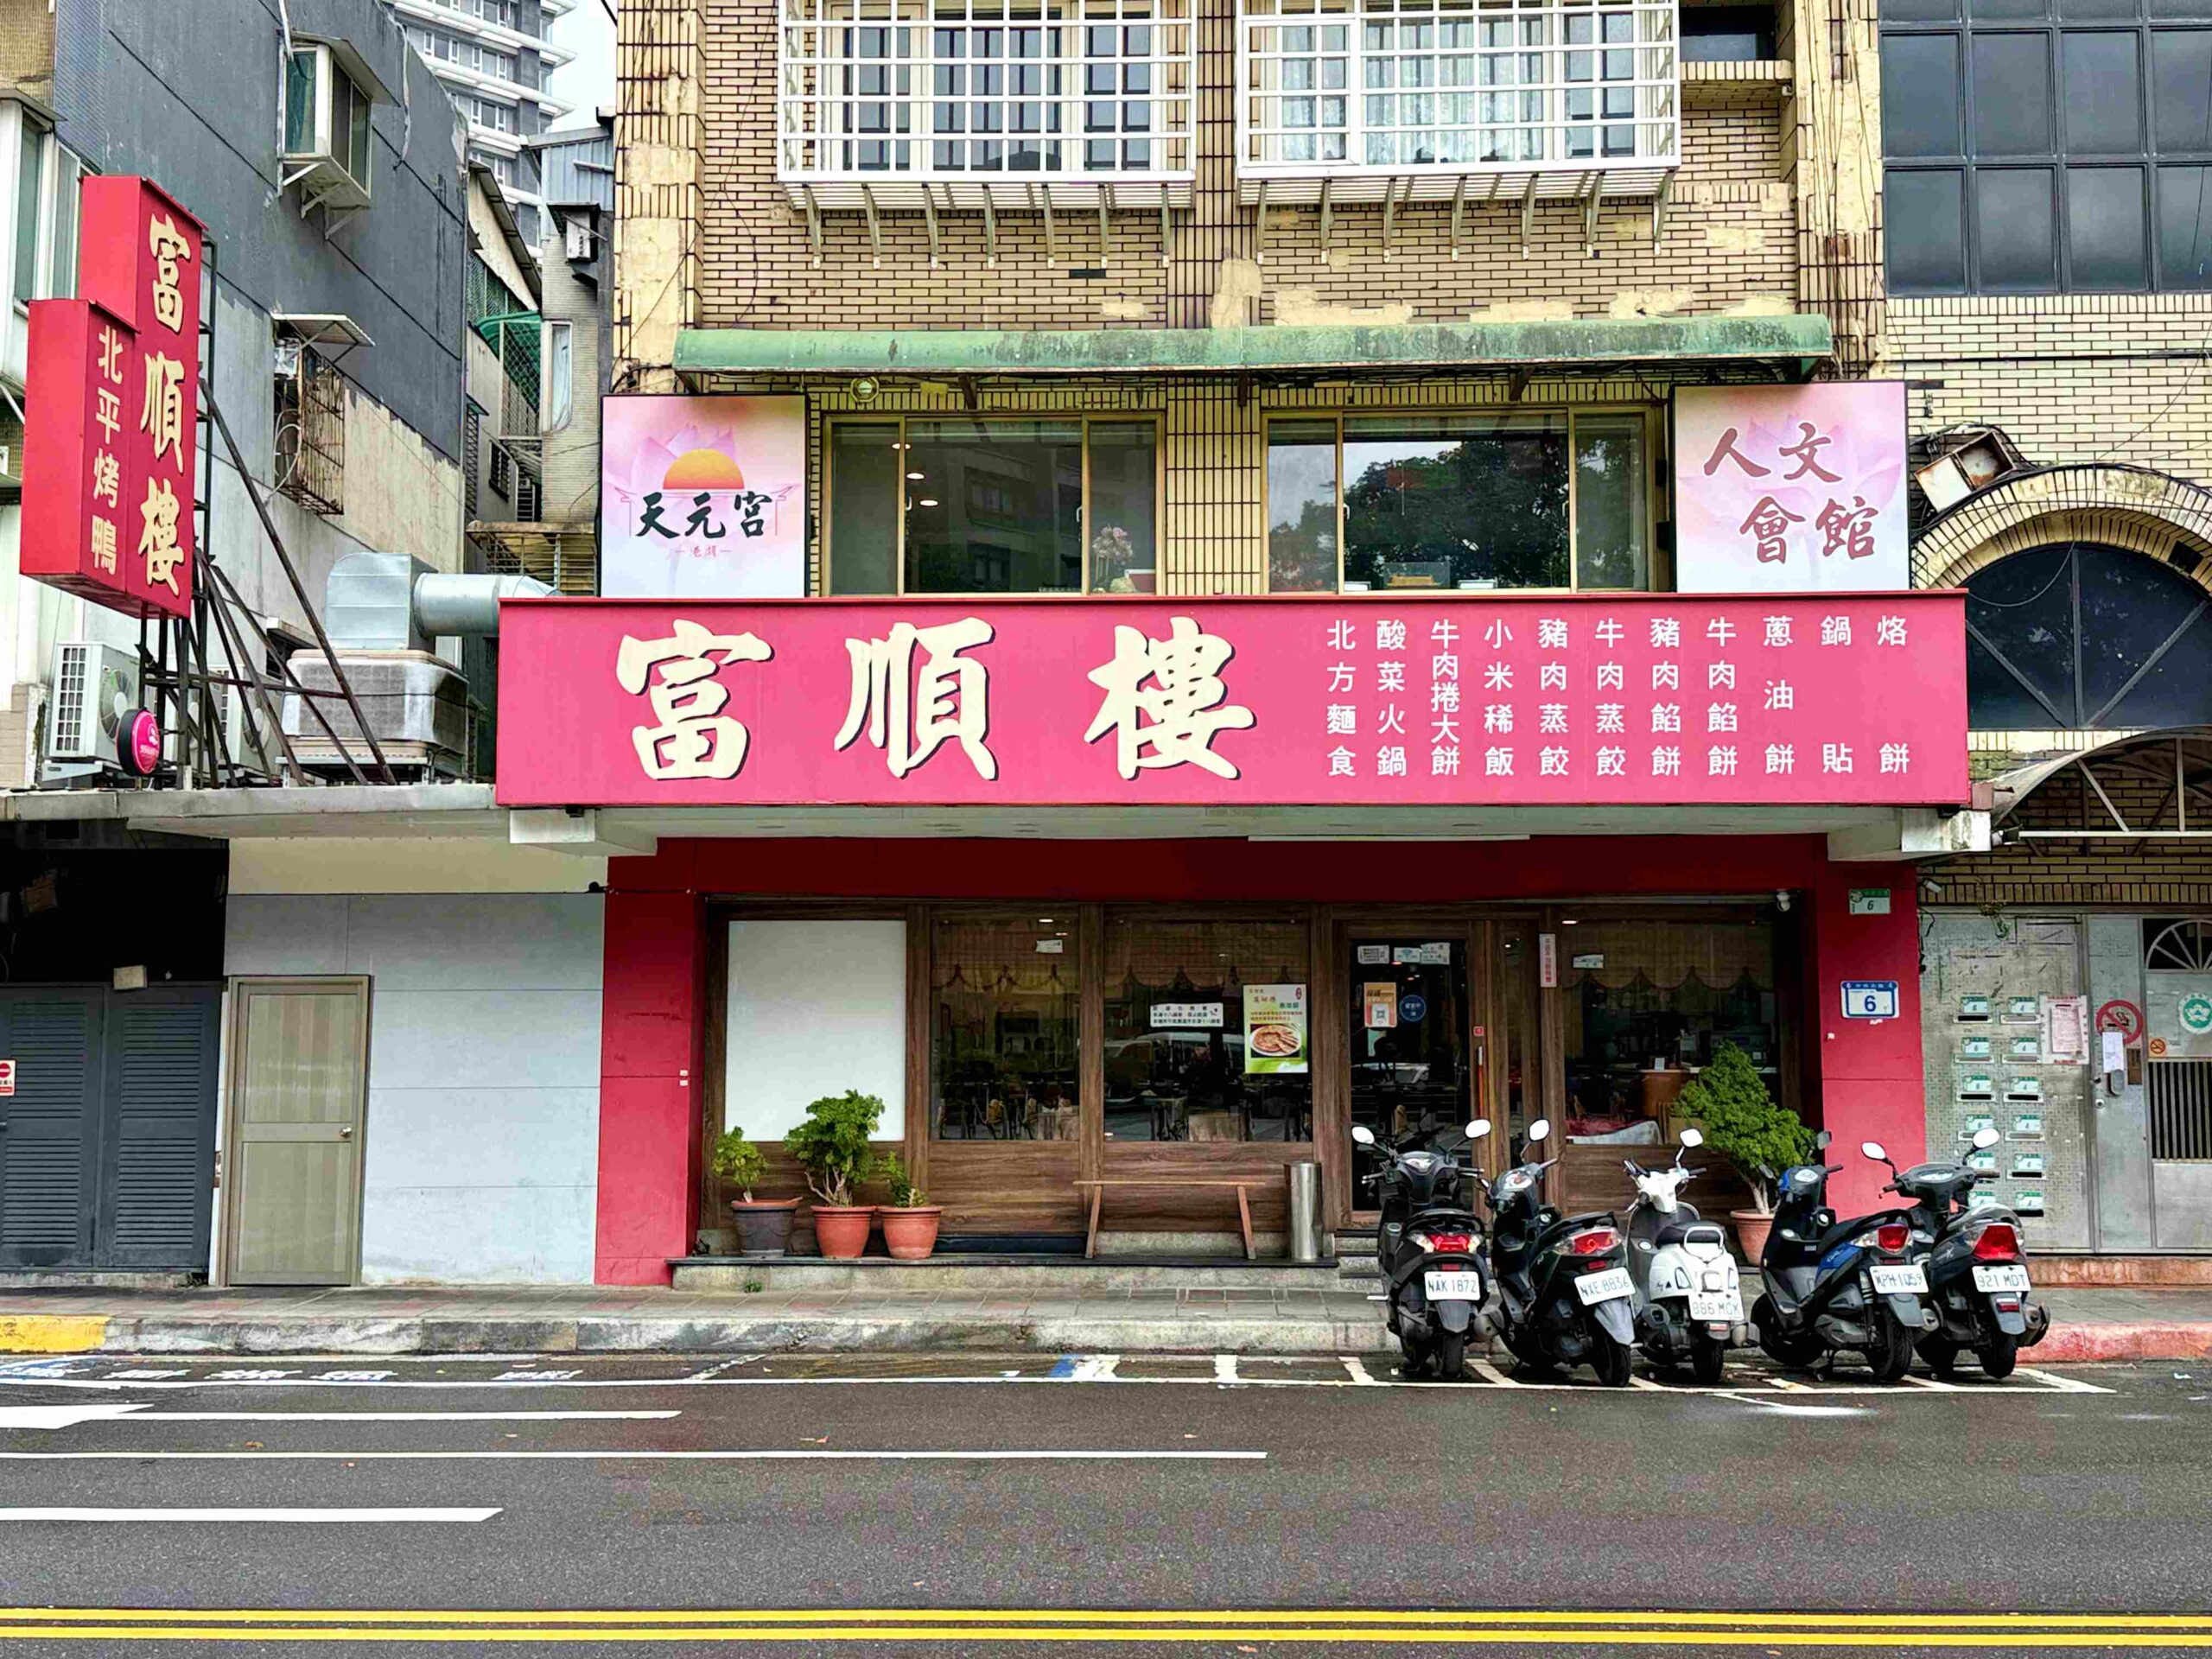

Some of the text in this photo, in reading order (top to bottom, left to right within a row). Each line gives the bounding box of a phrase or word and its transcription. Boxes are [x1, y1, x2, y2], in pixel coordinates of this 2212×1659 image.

[91, 324, 124, 575] 北平烤鴨
[138, 213, 191, 597] 富順樓
[1703, 422, 1842, 483] 人文
[635, 491, 772, 539] 天元宮
[1739, 495, 1879, 564] 會館
[616, 616, 1255, 781] 富順樓
[1327, 620, 1356, 777] 北方麵食
[1376, 620, 1407, 777] 酸菜火鍋
[1430, 619, 1460, 776] 牛肉捲大餅
[1484, 619, 1514, 776] 小米稀飯
[1538, 618, 1569, 776] 豬肉蒸餃
[1595, 618, 1625, 776] 牛肉蒸餃
[1650, 617, 1681, 776] 豬肉餡餅
[1707, 617, 1738, 775] 牛肉餡餅
[1764, 615, 1795, 774] 蔥油餅
[1867, 899, 1874, 911] 6
[1865, 995, 1877, 1013] 6
